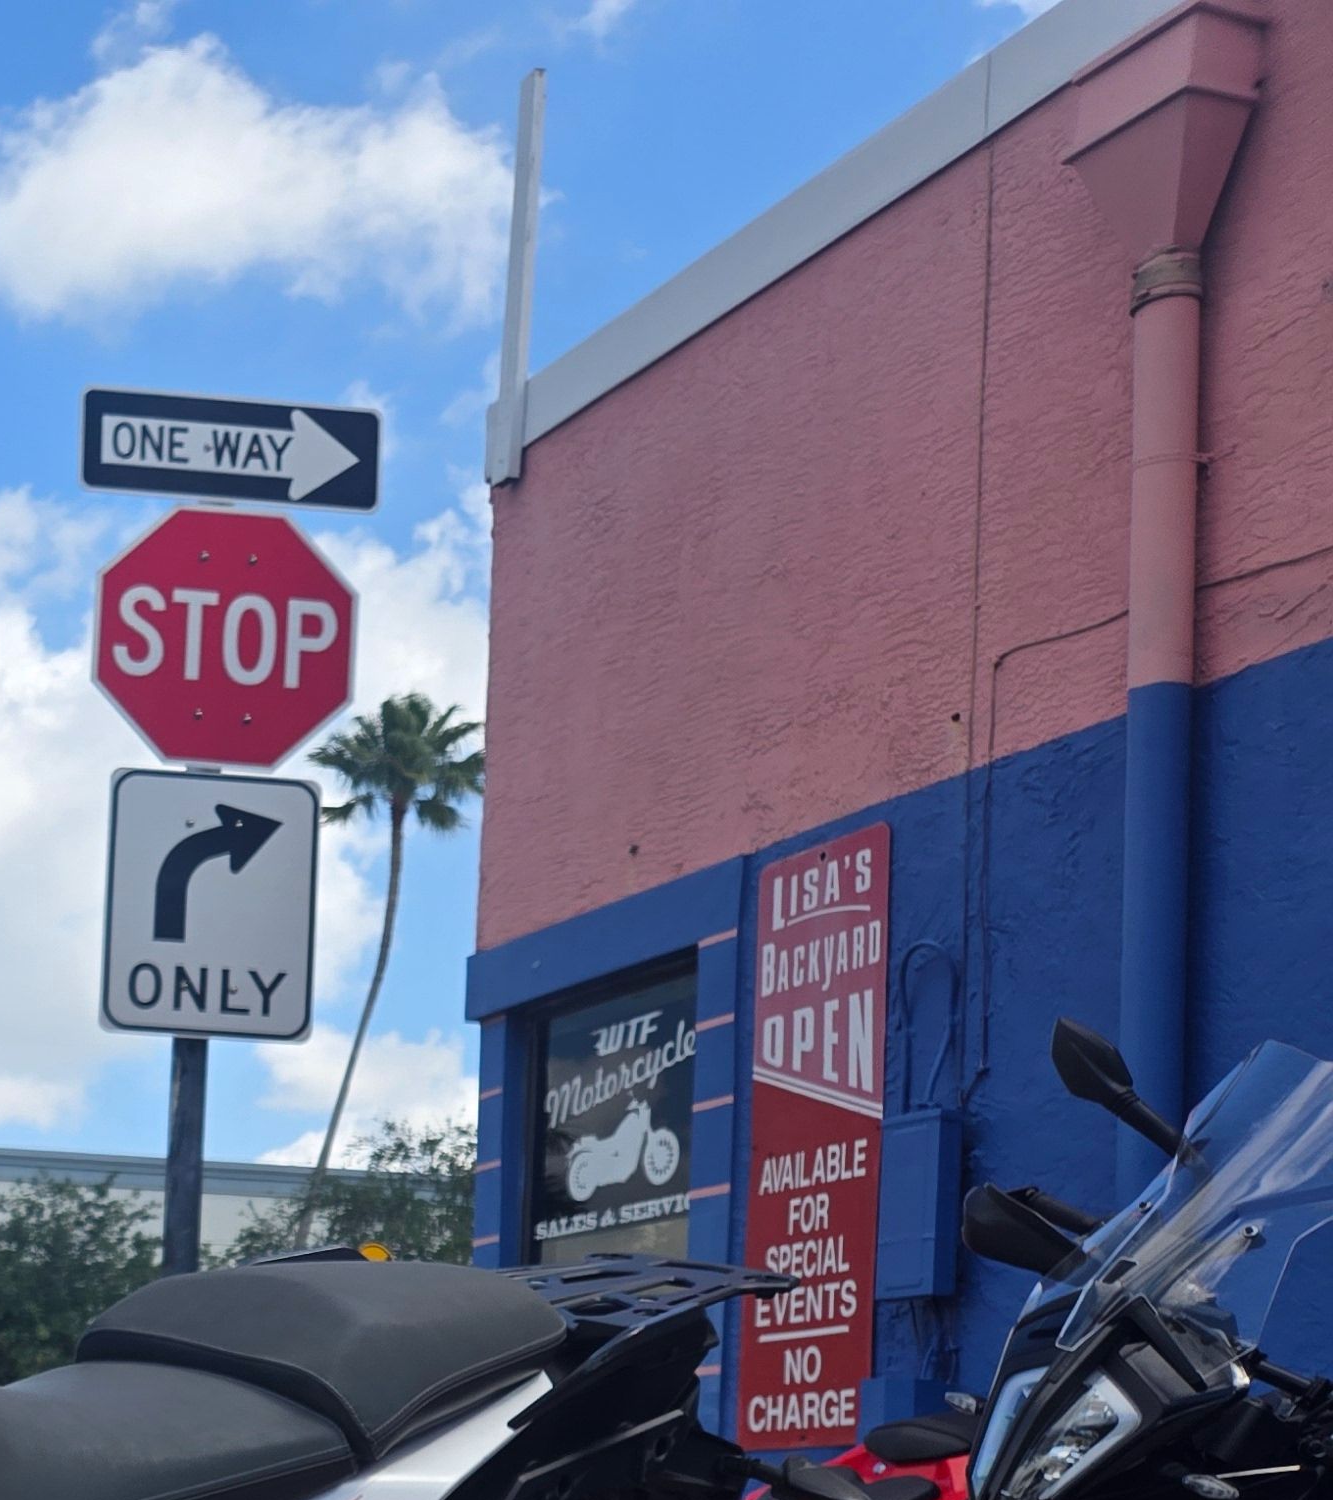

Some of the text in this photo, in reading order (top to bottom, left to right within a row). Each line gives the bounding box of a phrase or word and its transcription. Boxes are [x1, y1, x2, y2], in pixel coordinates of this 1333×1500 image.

[112, 422, 293, 473] ONE WAY
[111, 583, 339, 690] STOP
[771, 847, 873, 932] LISA'S
[760, 919, 882, 998] BACKYARD
[128, 961, 288, 1018] ONLY
[590, 1009, 663, 1057] WTF
[762, 988, 874, 1094] OPEN
[544, 1019, 697, 1129] Motorcycle
[758, 1137, 869, 1197] AVAILABLE
[534, 1192, 691, 1241] SALES & SERVI
[787, 1191, 830, 1237] FOR
[765, 1234, 851, 1279] SPECIAL
[754, 1278, 858, 1329] EVENTS
[784, 1344, 823, 1386] NO
[747, 1387, 857, 1433] CHARGE
